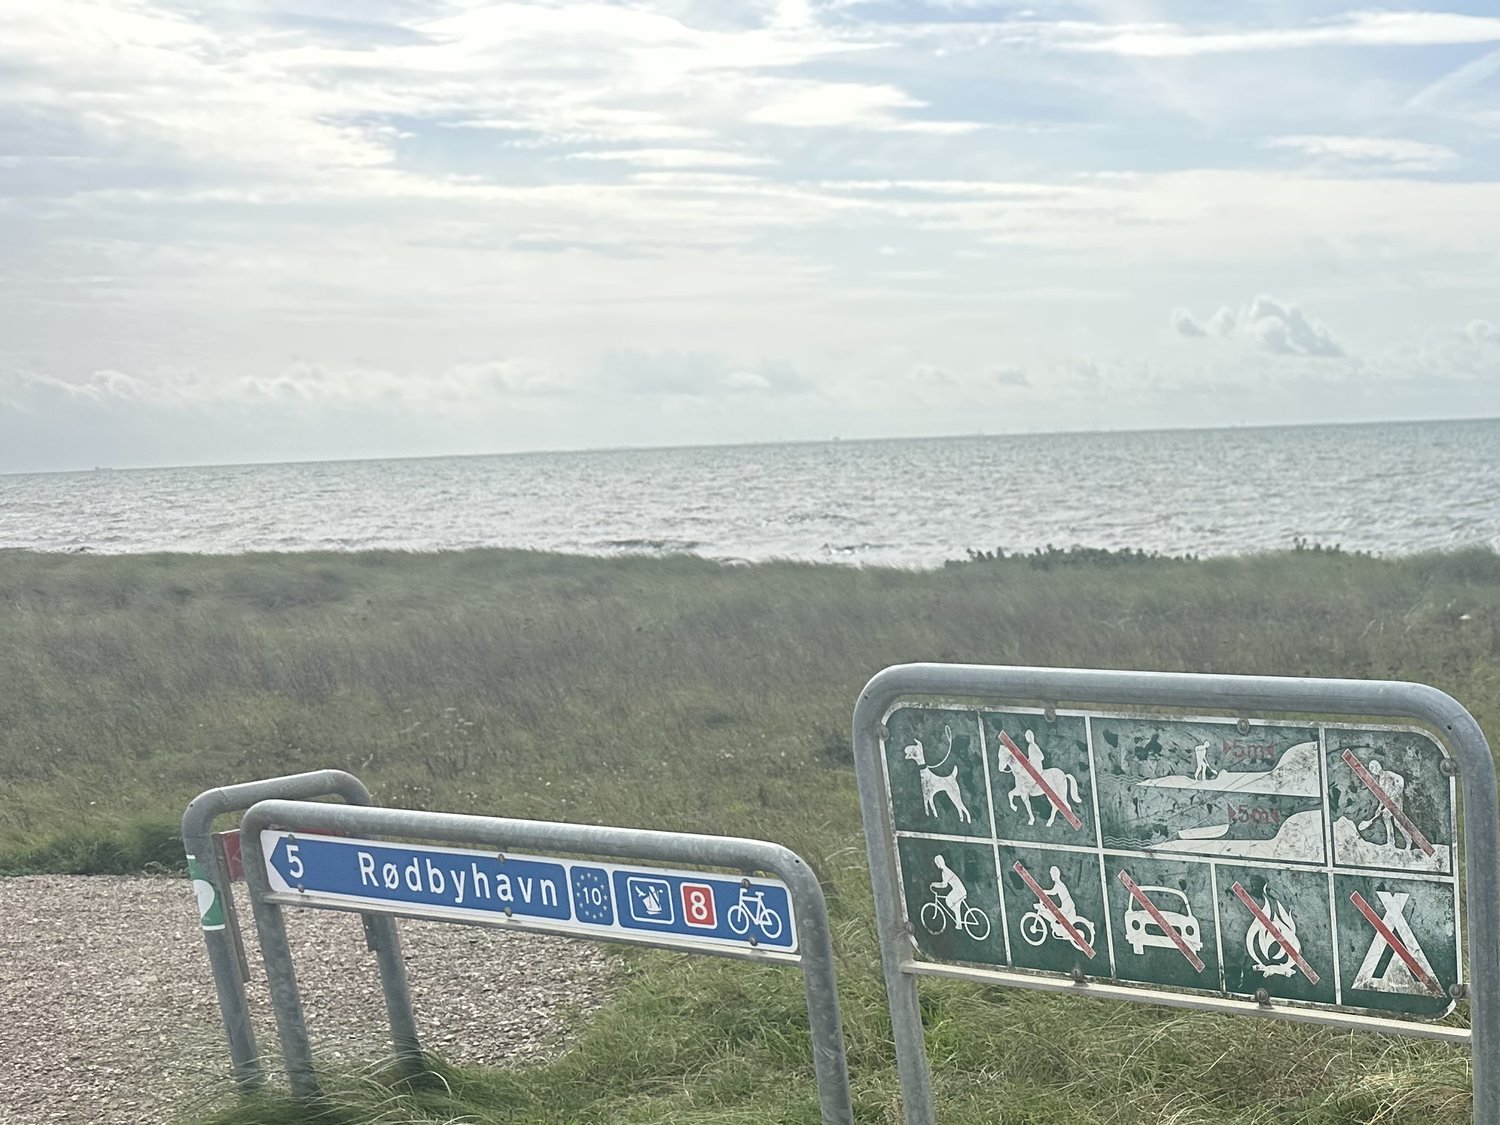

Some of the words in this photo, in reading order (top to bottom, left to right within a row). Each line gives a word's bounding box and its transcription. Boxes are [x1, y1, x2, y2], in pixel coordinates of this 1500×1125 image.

[285, 844, 304, 879] 5
[357, 851, 559, 907] Rødbyhavn
[583, 886, 602, 906] 10
[690, 891, 709, 921] 8
